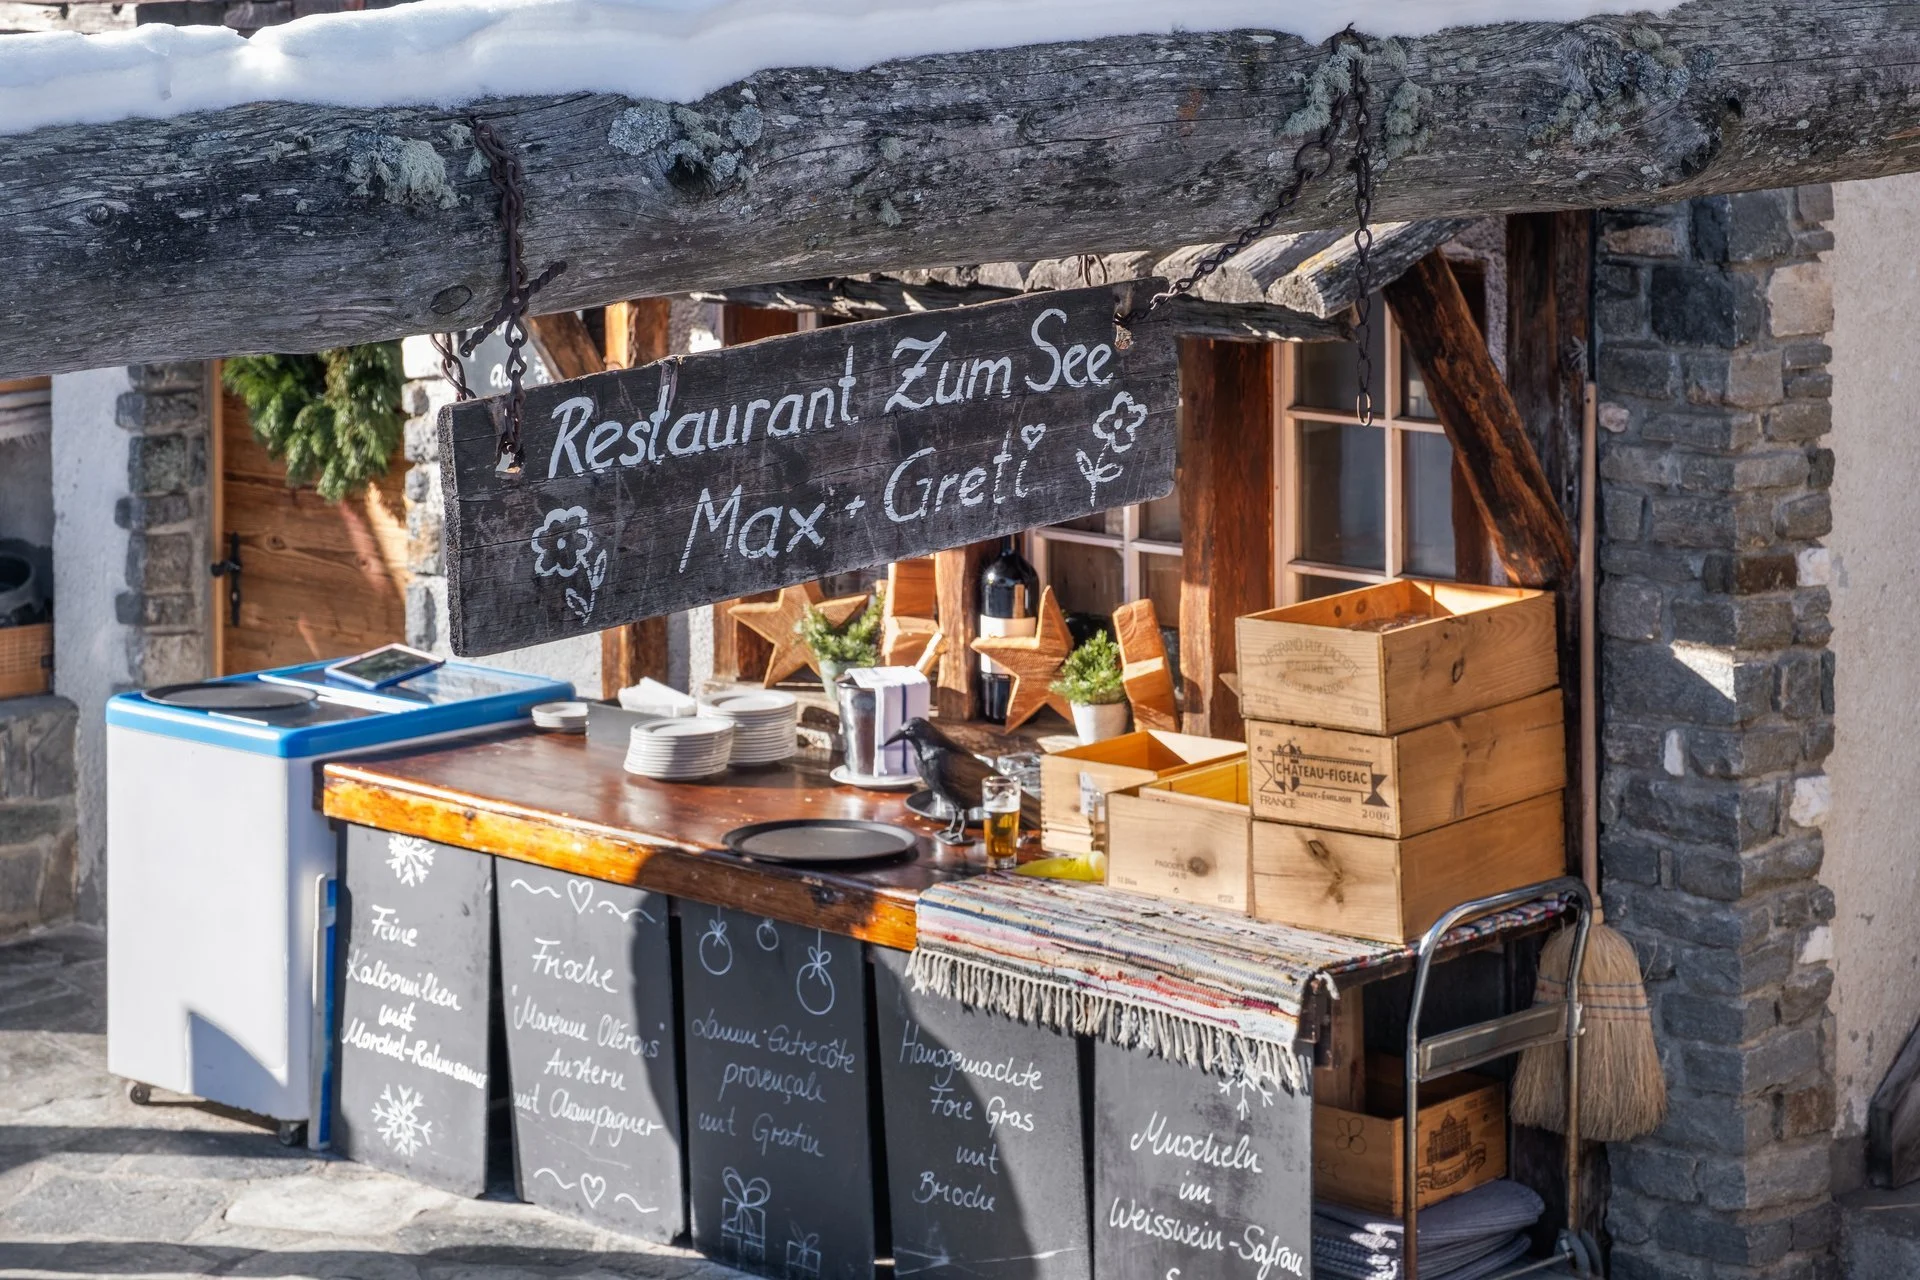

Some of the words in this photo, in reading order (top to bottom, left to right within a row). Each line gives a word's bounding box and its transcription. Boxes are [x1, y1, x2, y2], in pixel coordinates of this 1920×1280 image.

[547, 344, 859, 479] Restaurant
[884, 330, 1012, 414] Zum
[1025, 308, 1114, 393] See
[678, 484, 825, 574] Max
[883, 426, 1030, 524] Greti
[1260, 794, 1296, 810] FRANCE
[1361, 808, 1390, 821] 2000
[371, 904, 418, 947] Feine
[531, 937, 619, 994] Frische
[379, 1003, 417, 1033] mit
[544, 1048, 627, 1091] Austern
[899, 1019, 1044, 1091] Hausgemachte
[549, 1087, 664, 1148] Champagner
[698, 1106, 738, 1137] mit
[751, 1112, 825, 1157] Gratin
[929, 1085, 974, 1121] Foie
[985, 1096, 1036, 1138] Gras
[956, 1142, 1000, 1175] mit
[1130, 1110, 1263, 1173] Muscheln
[1178, 1170, 1212, 1204] im
